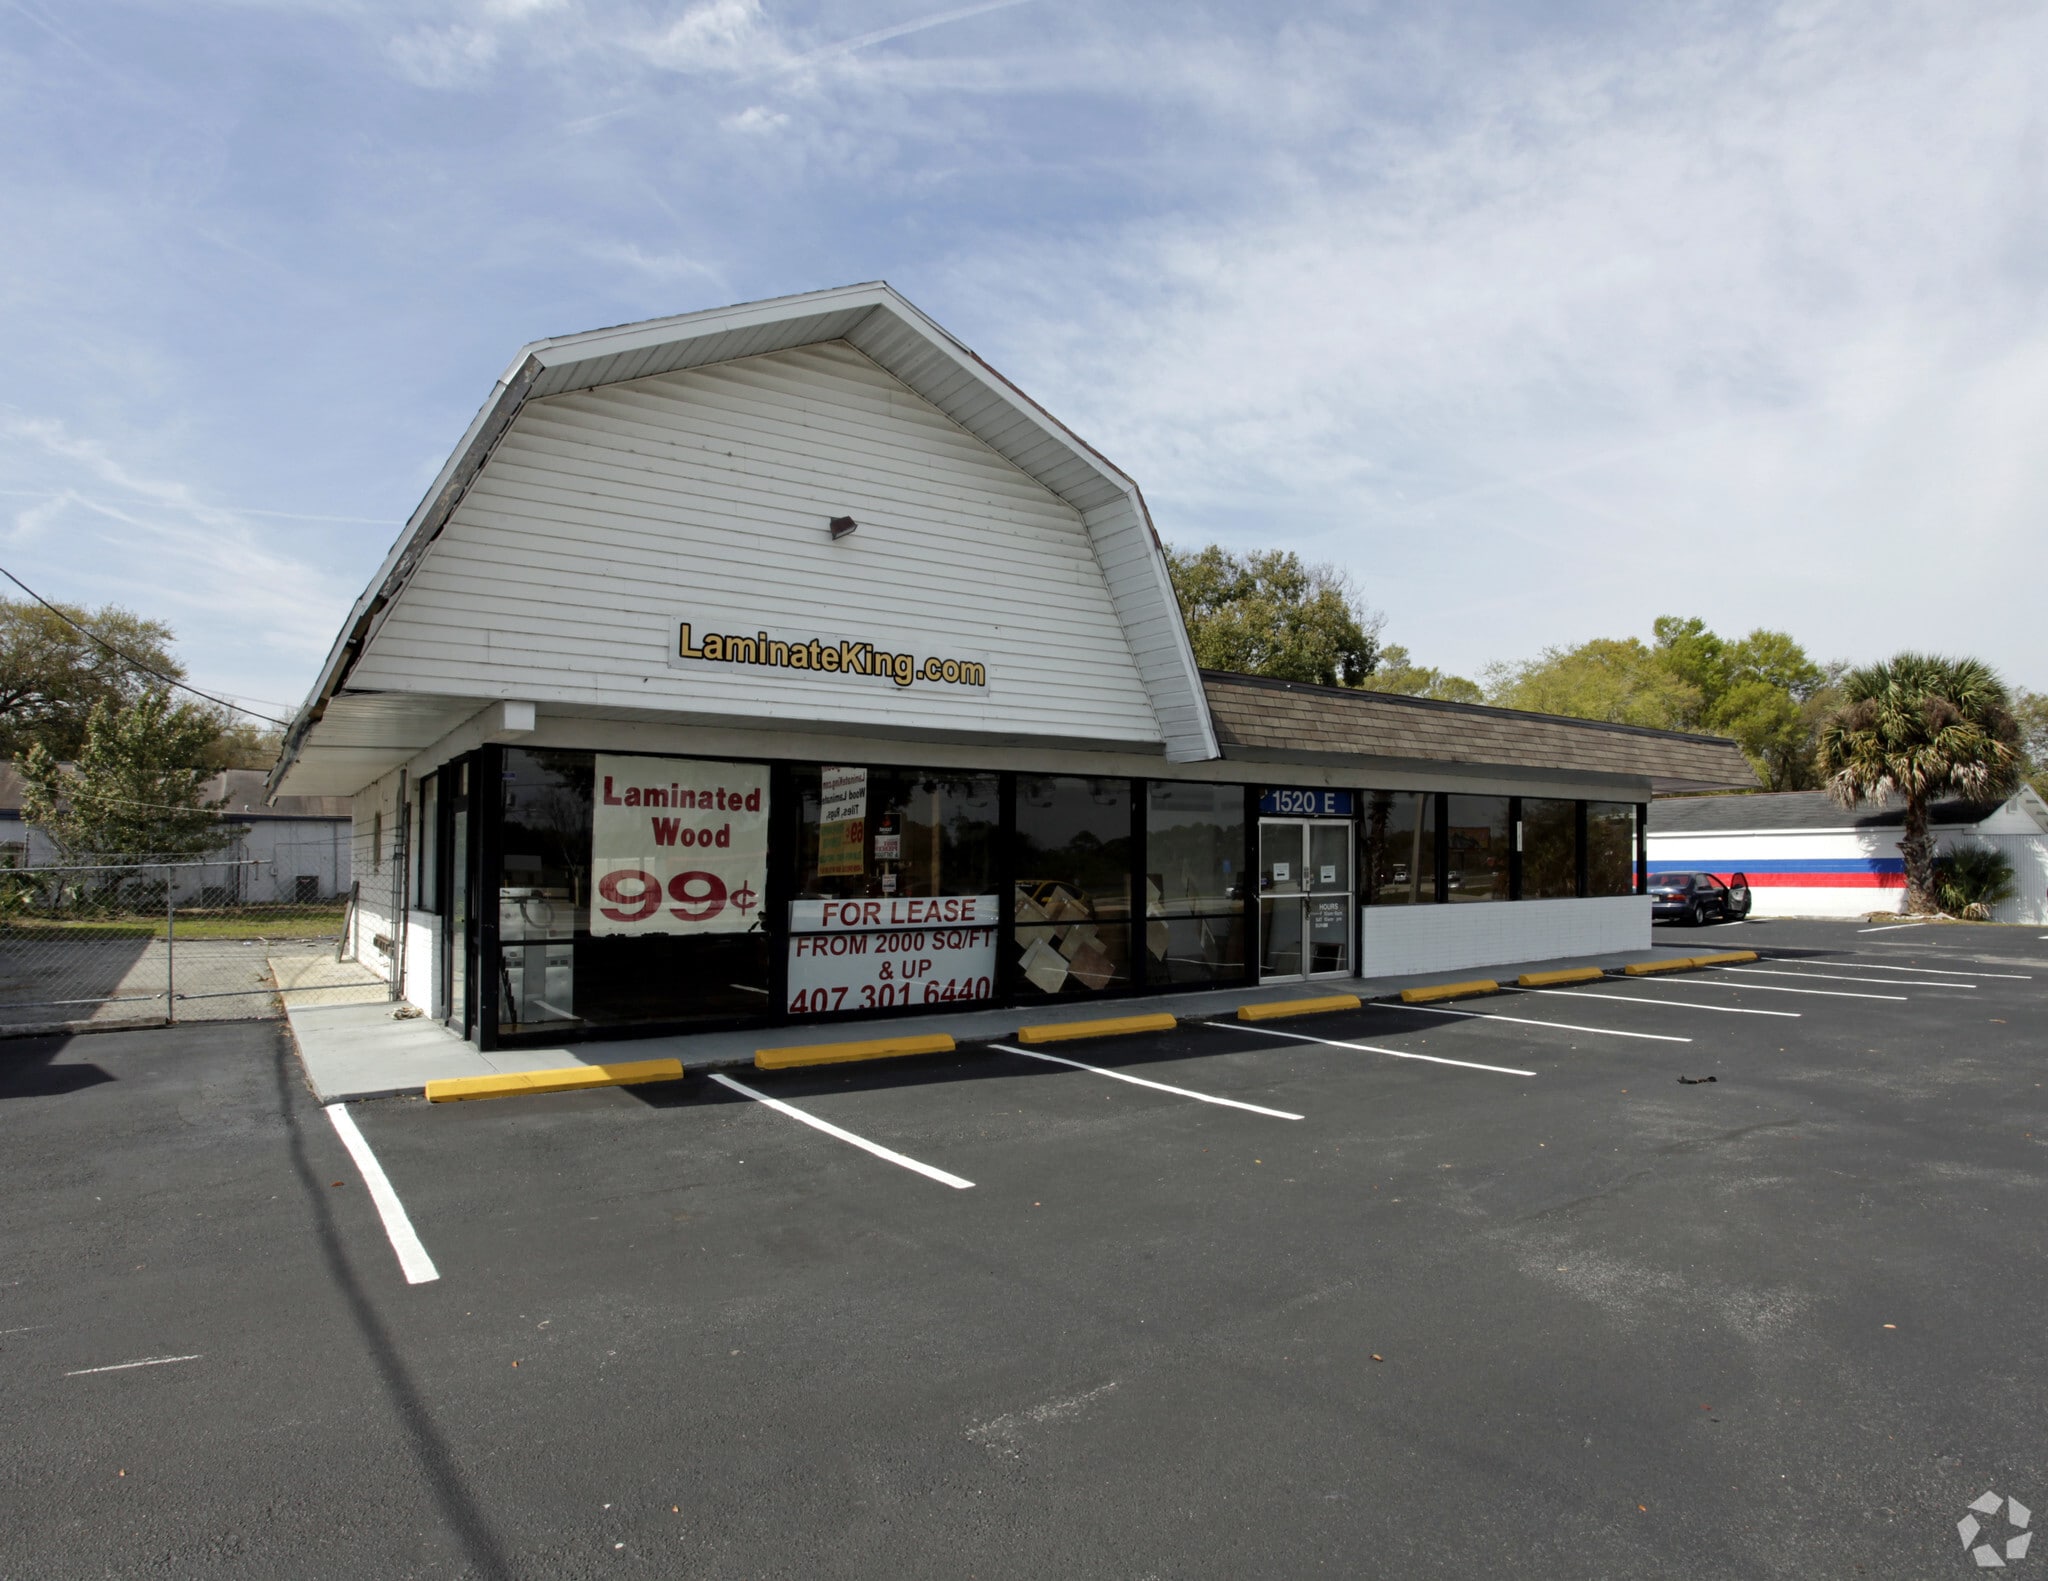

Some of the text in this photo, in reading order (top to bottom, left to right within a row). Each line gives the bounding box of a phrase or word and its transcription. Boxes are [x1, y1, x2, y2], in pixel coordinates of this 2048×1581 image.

[679, 622, 986, 686] LaminateKing.com
[603, 776, 761, 812] Laminated
[1272, 790, 1336, 813] 1520 E
[651, 817, 730, 848] Wood
[598, 869, 758, 922] 99¢
[822, 898, 976, 926] FOR LEASE
[796, 928, 994, 957] FROM 2000 SQ/FT
[879, 959, 932, 980] & UP
[789, 976, 991, 1014] 407 301 6440
